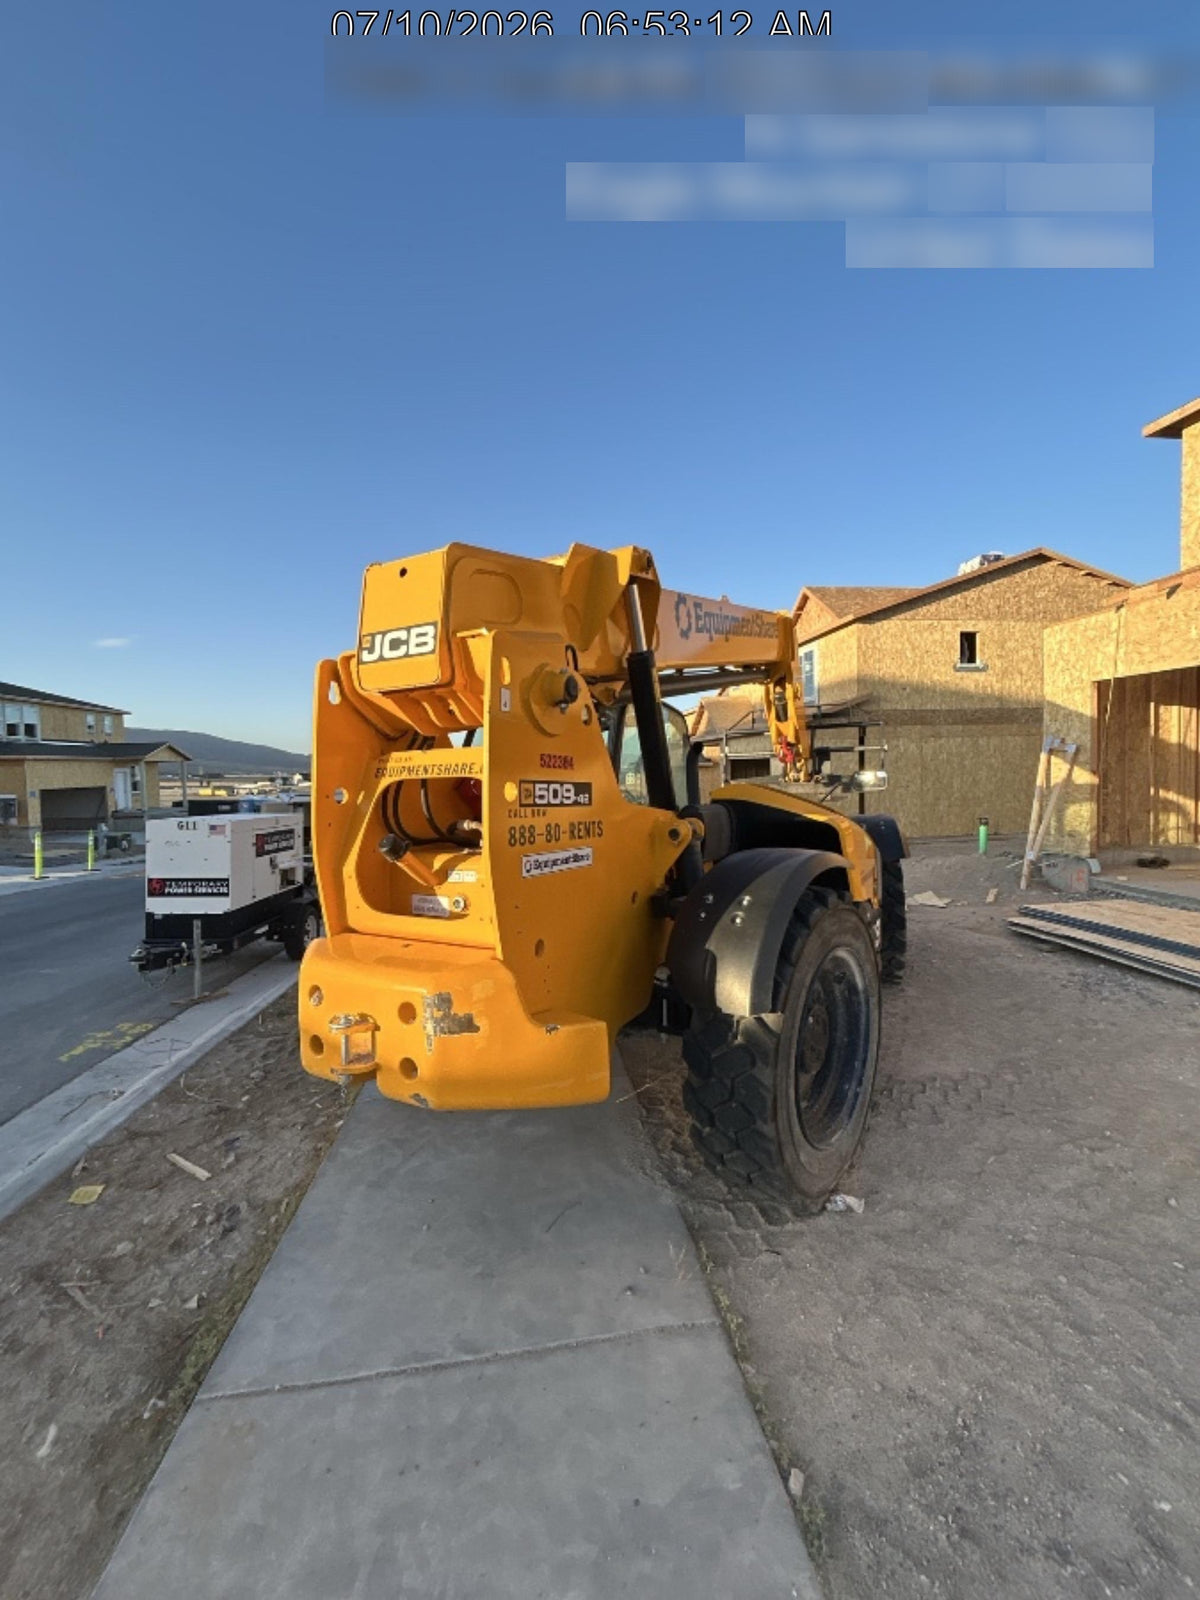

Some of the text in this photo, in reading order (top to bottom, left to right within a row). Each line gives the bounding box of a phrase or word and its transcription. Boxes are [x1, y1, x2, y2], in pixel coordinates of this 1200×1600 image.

[361, 624, 435, 662] JCB
[508, 808, 528, 818] CALL
[508, 820, 603, 847] 888-80-RENTS
